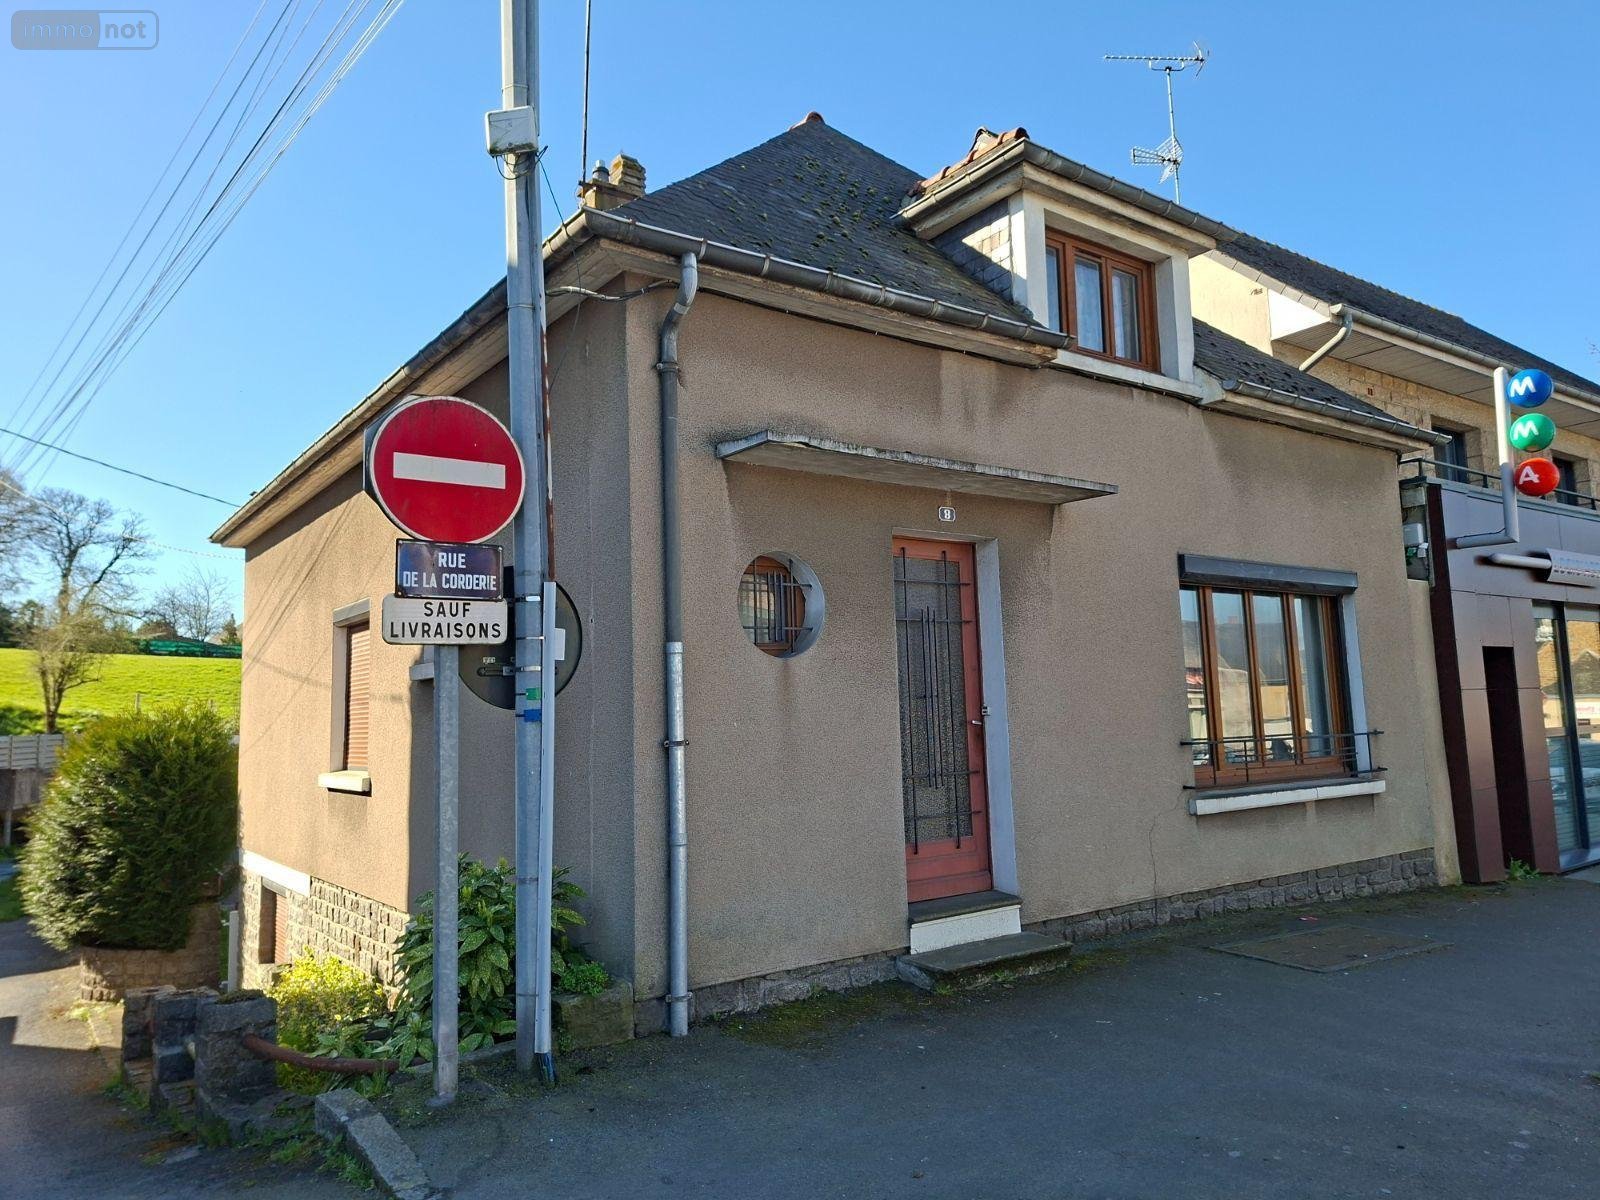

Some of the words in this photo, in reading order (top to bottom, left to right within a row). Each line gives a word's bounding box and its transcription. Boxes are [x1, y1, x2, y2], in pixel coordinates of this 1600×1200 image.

[1510, 376, 1536, 398] M
[1513, 420, 1539, 441] M
[1519, 465, 1540, 485] A
[943, 509, 951, 520] 8
[438, 552, 466, 568] RUE
[403, 571, 419, 588] DE
[423, 572, 437, 588] LA
[441, 573, 497, 591] CORDERIE
[423, 601, 471, 618] SAUF
[390, 621, 501, 639] LIVRAISONS
